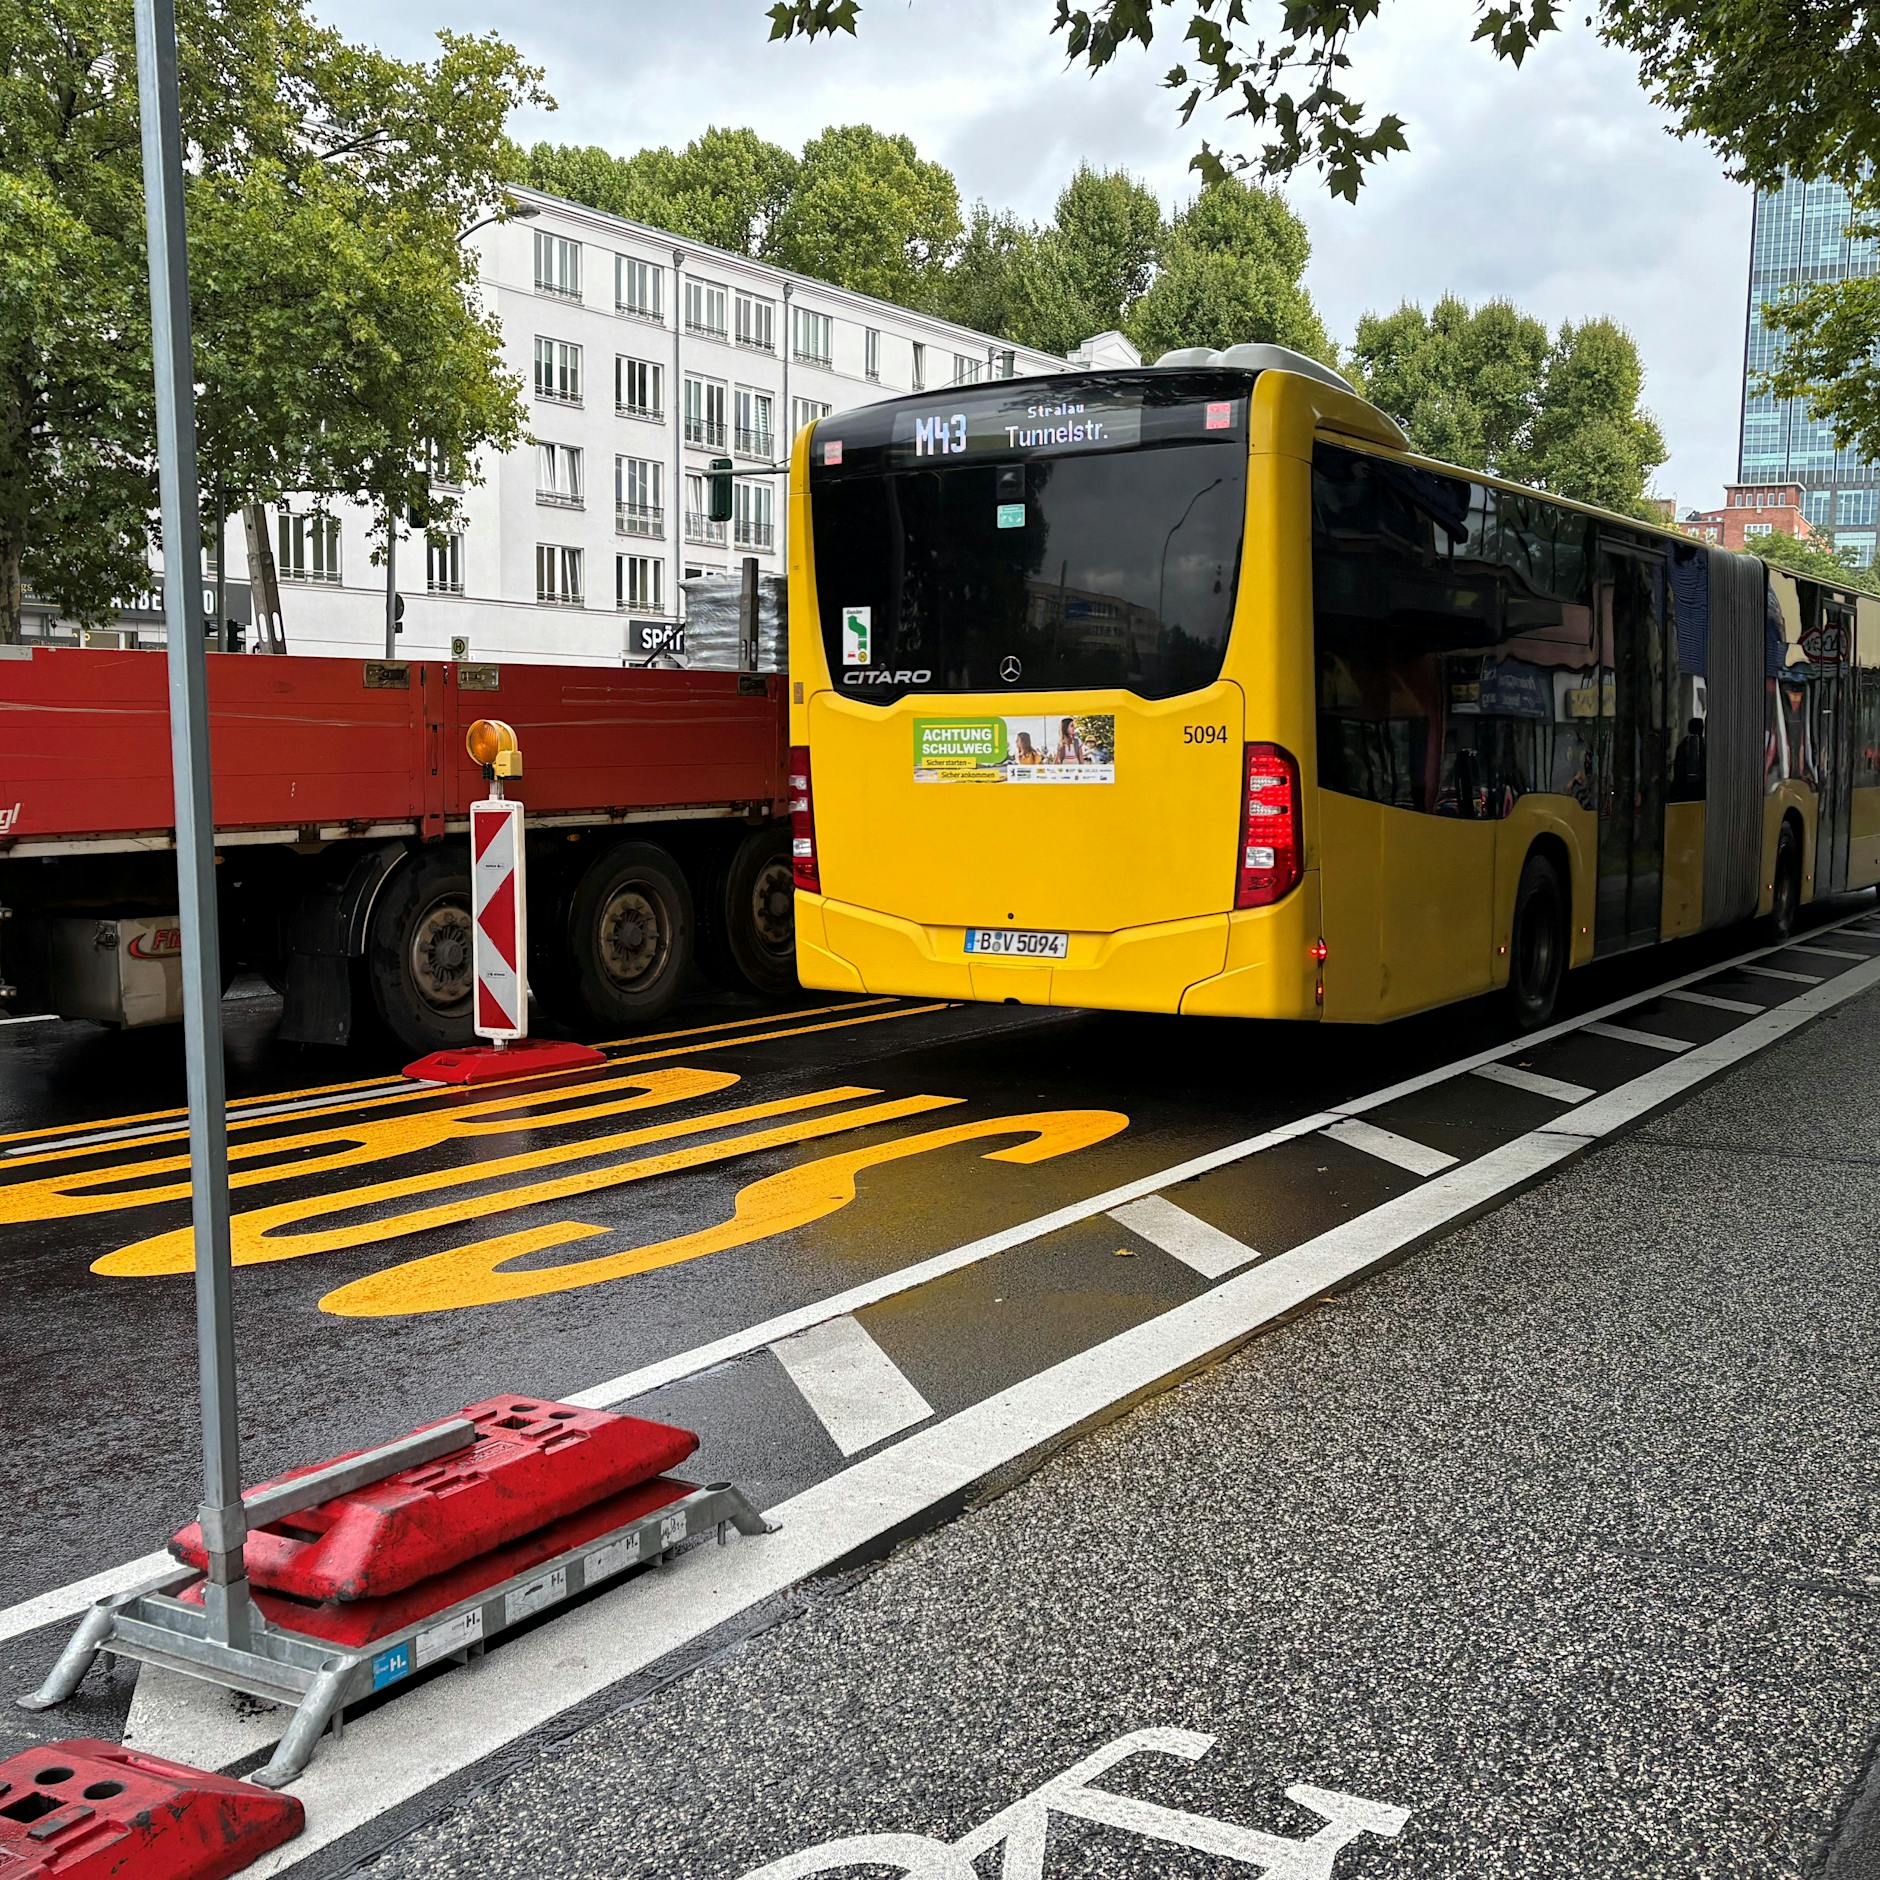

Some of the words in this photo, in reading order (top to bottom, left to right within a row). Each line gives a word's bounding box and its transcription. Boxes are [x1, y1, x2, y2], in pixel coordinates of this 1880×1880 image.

[1027, 403, 1085, 419] Stralau
[915, 413, 967, 457] M43
[1005, 419, 1109, 448] Tunnelstr.
[843, 669, 932, 685] CITARO
[923, 728, 992, 741] ACHTUNG
[1183, 725, 1228, 744] 5094
[1017, 935, 1060, 954] 5094
[0, 1066, 1130, 1317] BUS
